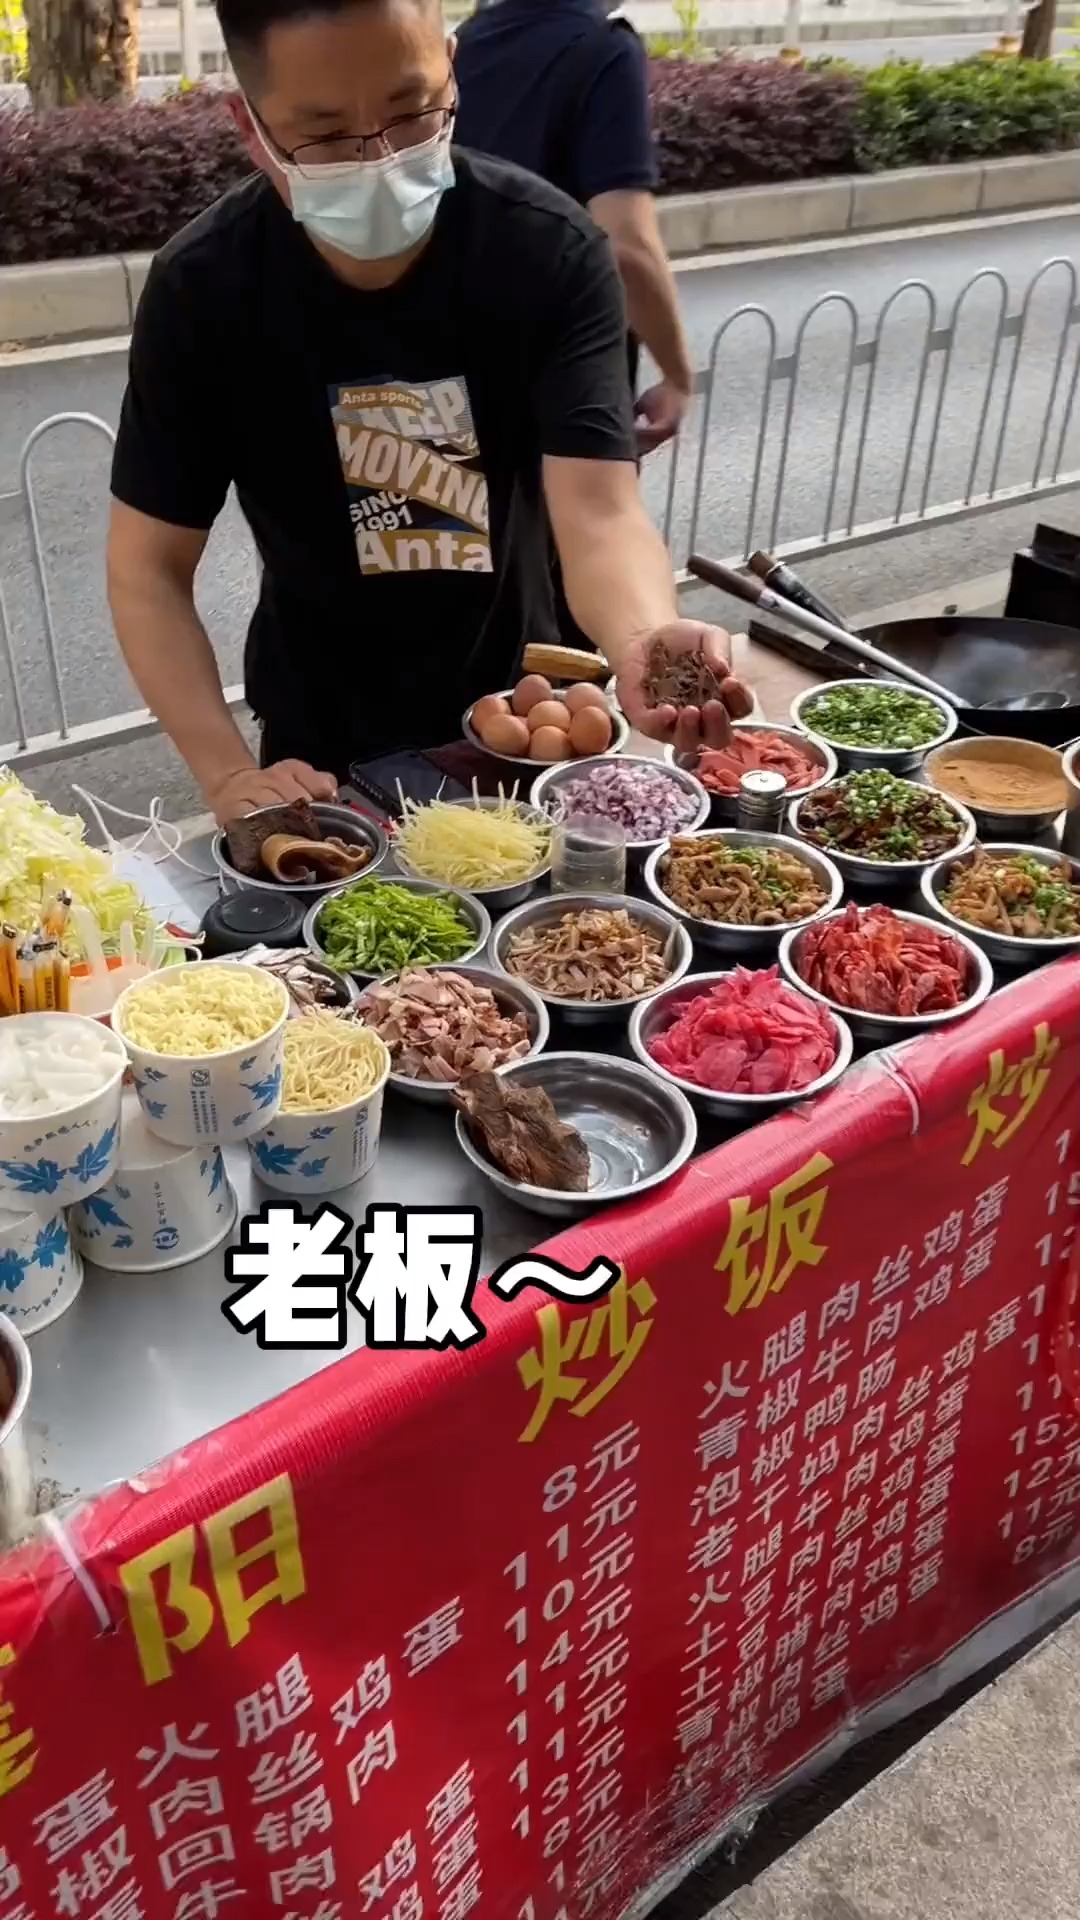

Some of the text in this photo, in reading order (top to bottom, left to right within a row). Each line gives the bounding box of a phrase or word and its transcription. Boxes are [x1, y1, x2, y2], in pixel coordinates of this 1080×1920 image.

[341, 391, 422, 408] Anta sports
[356, 531, 494, 573] Anta
[694, 1227, 998, 1470] 青椒牛肉鸡蛋
[698, 1175, 1010, 1418] 火腿肉丝鸡蛋
[542, 1420, 641, 1512] 8元
[686, 1296, 1022, 1572] 老干妈肉丝鸡蛋
[690, 1346, 897, 1526] 泡椒鸭肠
[503, 1477, 637, 1592] 11元
[681, 1419, 960, 1672] 土豆肉丝鸡蛋
[686, 1374, 969, 1625] 火腿牛肉鸡蛋
[504, 1532, 635, 1644] 10元
[505, 1583, 632, 1696] 14元
[672, 1508, 947, 1754] 青椒腊肉鸡蛋
[676, 1465, 954, 1715] 土豆牛肉鸡蛋
[506, 1633, 630, 1745] 11元
[508, 1680, 627, 1794] 11元
[511, 1726, 625, 1840] 13元
[542, 1769, 623, 1859] 8元
